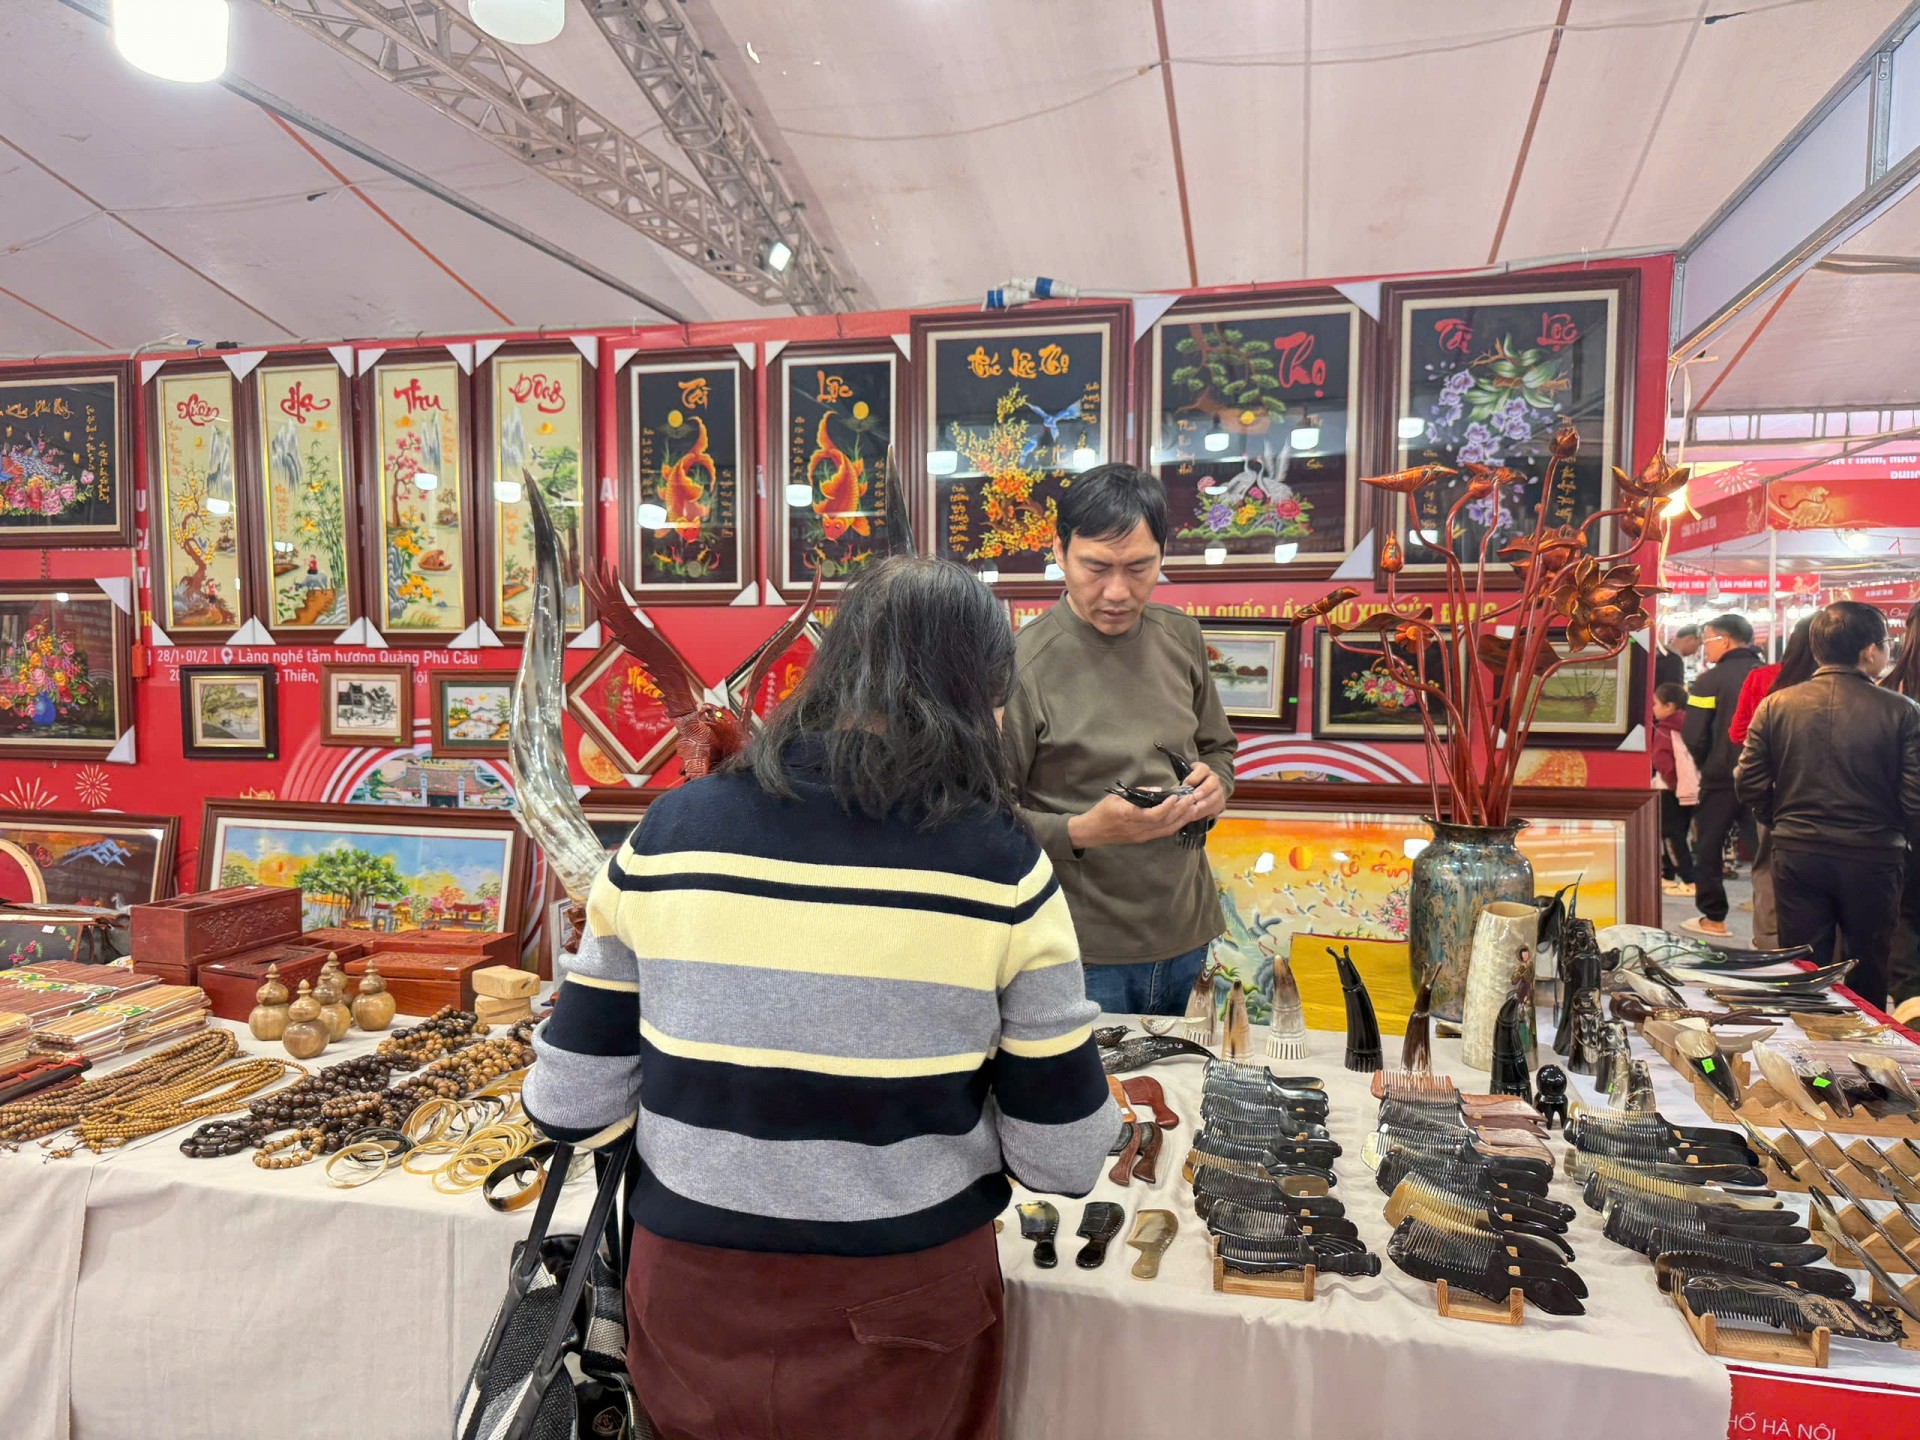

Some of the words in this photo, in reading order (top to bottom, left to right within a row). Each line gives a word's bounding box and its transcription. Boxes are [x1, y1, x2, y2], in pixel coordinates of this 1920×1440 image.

[1274, 332, 1326, 398] Thọ
[280, 381, 331, 424] Hạ
[394, 378, 448, 414] Thu
[238, 650, 269, 664] Làng
[423, 650, 449, 664] Phú
[284, 668, 319, 684] Thiên,
[1728, 1412, 1757, 1432] HỐ
[1762, 1418, 1791, 1437] HÀ
